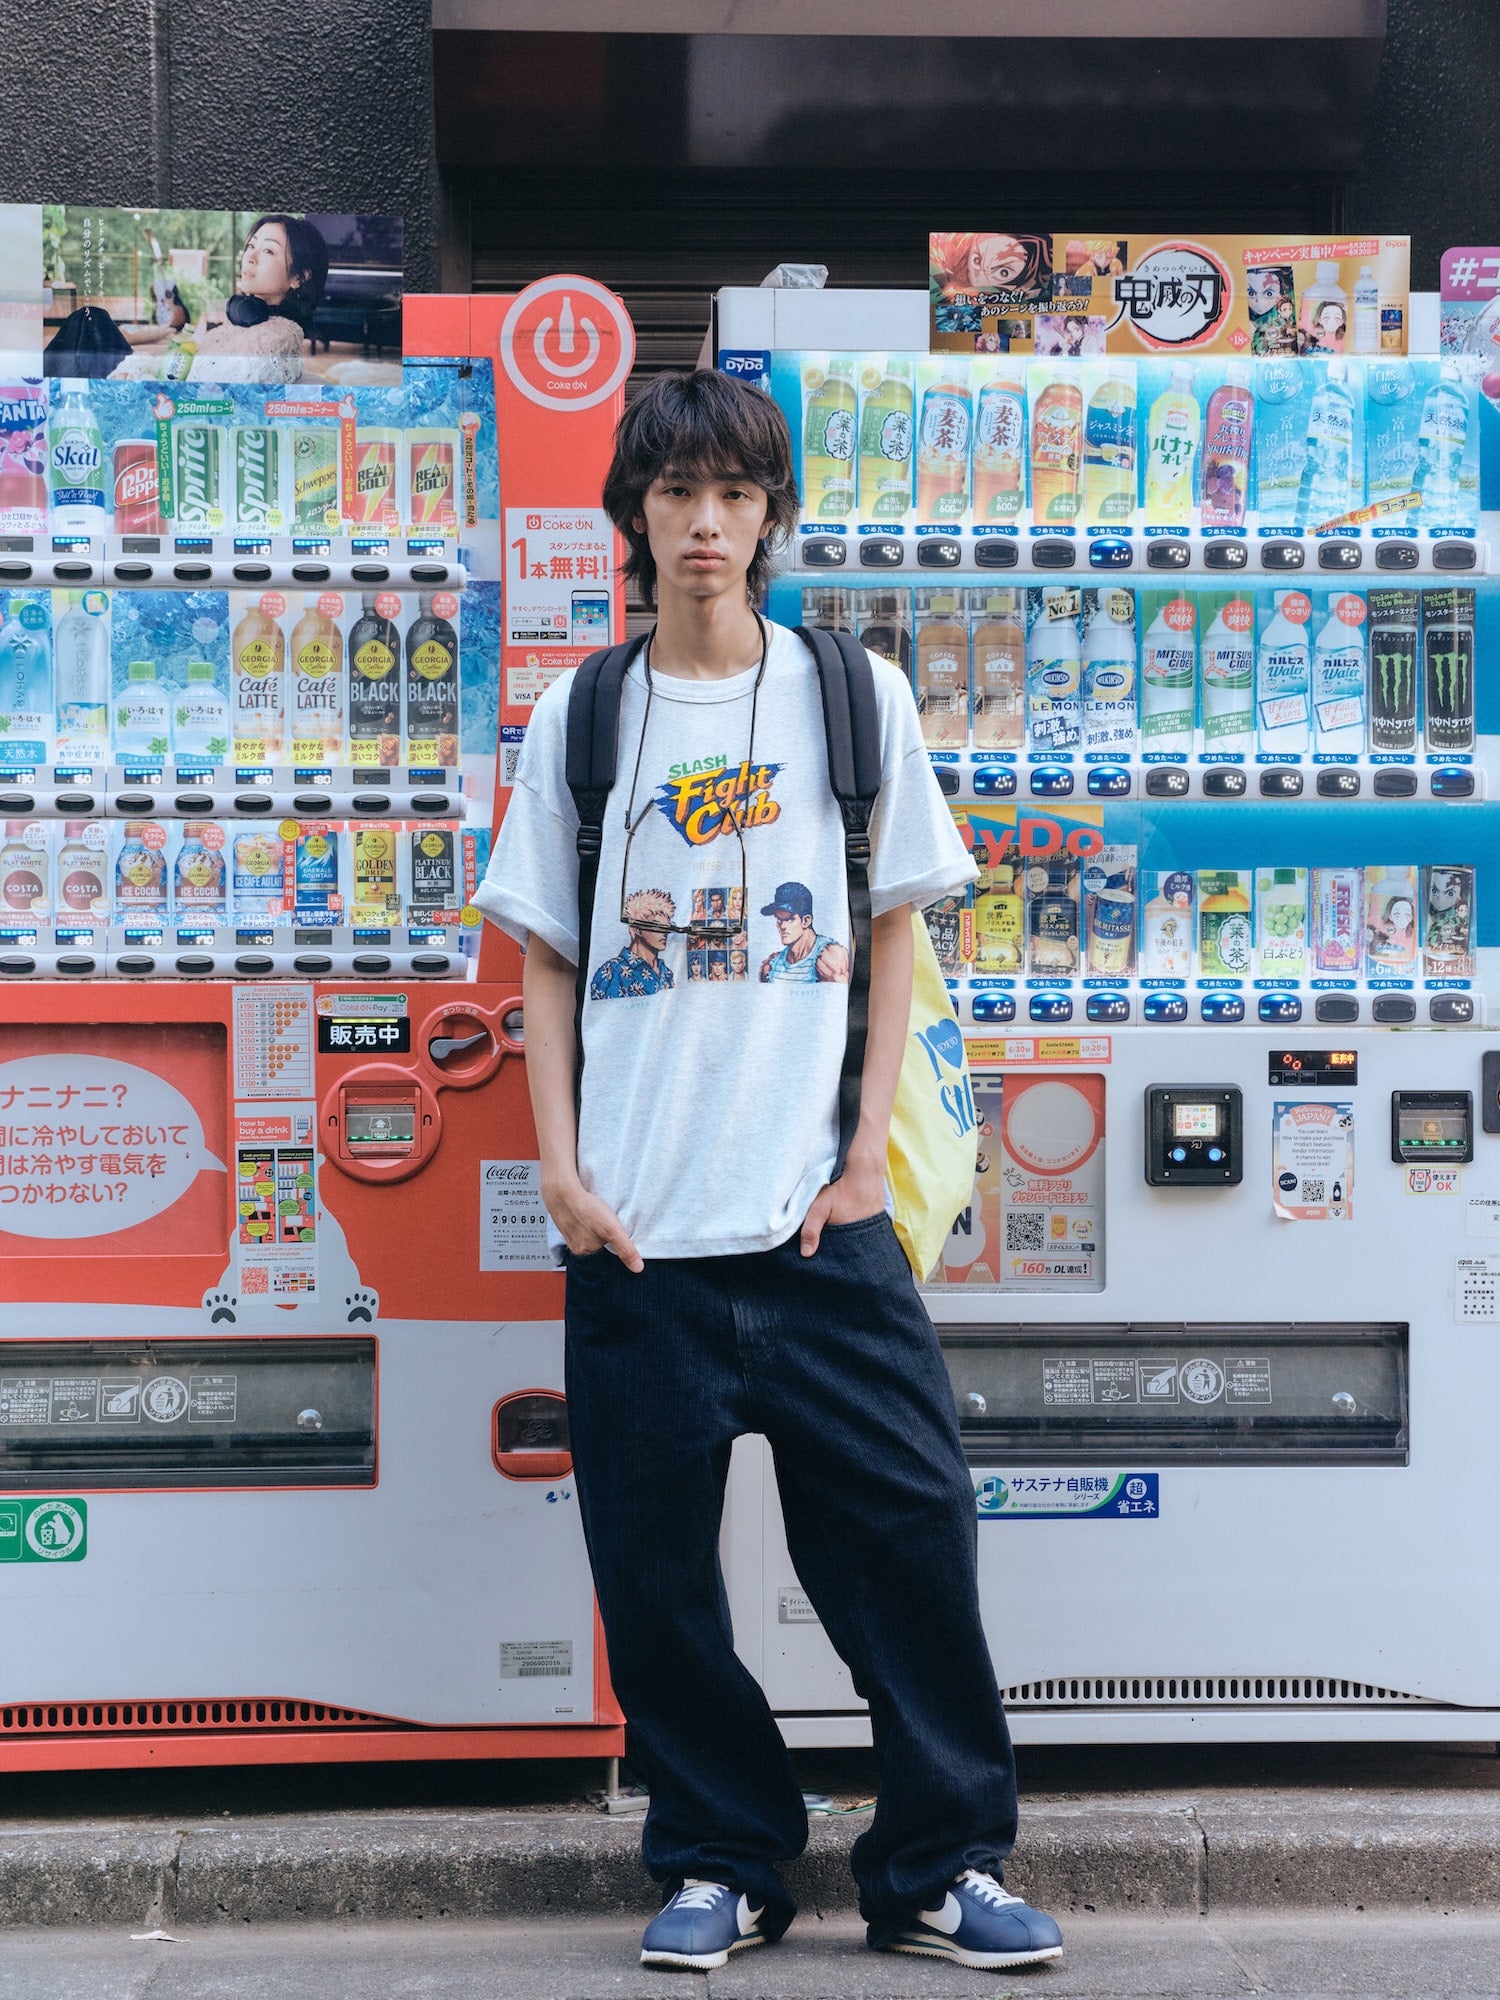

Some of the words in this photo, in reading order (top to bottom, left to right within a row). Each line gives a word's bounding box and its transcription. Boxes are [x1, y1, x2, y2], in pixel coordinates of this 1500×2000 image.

[1244, 245, 1336, 264] キャンペーン実施中!
[1143, 264, 1208, 274] きめつのやいば
[954, 291, 1024, 306] 想いをつなぐ!
[1104, 272, 1221, 331] 鬼滅の刃
[981, 300, 1089, 316] あのシーンを振り返ろう!
[725, 358, 764, 372] DyDo
[546, 381, 571, 390] Coke
[991, 406, 1013, 446] 麦茶
[1312, 412, 1350, 429] 天然水
[1424, 412, 1464, 429] 天然水
[835, 412, 851, 457] 葉の茶
[890, 413, 906, 458] 葉の茶
[936, 409, 953, 448] 麦茶
[1089, 420, 1134, 437] ジャスミン茶
[1152, 437, 1194, 455] バナナ
[134, 467, 156, 481] Dr
[178, 429, 212, 522] Sprite
[238, 429, 269, 522] Sprite
[357, 464, 391, 480] REAL
[416, 464, 448, 482] REAL
[294, 471, 338, 497] Schweppes
[357, 477, 390, 493] GOLD
[415, 477, 448, 494] GOLD
[542, 520, 573, 530] Coke
[549, 542, 607, 550] スタンプたまると
[511, 537, 608, 580] 1本無料!
[1168, 614, 1192, 626] 爽快
[1371, 607, 1418, 618] モンスターエナジー
[1227, 615, 1250, 627] 爽快
[241, 655, 277, 664] GEORGIA
[357, 655, 392, 664] GEORGIA
[542, 657, 563, 665] Coke
[929, 652, 956, 660] COFFEE
[1267, 656, 1305, 666] カルピス
[1323, 658, 1359, 668] カルピス
[1266, 662, 1305, 678] Water
[1322, 665, 1360, 681] Water
[238, 677, 278, 691] Café
[297, 677, 336, 691] Café
[350, 681, 400, 702] BLACK
[407, 681, 457, 702] BLACK
[238, 694, 278, 710] LATTE
[297, 694, 337, 710] LATTE
[1032, 701, 1079, 711] LEMON
[1086, 701, 1135, 711] LEMON
[5, 749, 39, 759] 天然水
[234, 742, 266, 751] 軽やかな
[235, 752, 266, 761] ミルク感
[668, 754, 728, 780] SLASH
[664, 761, 776, 826] Fight
[356, 859, 394, 871] GOLDEN
[414, 859, 451, 867] PLATINUM
[285, 844, 294, 909] お手頃価格!
[414, 865, 452, 880] BLACK
[6, 884, 40, 893] COSTA
[65, 884, 99, 893] COSTA
[121, 887, 133, 897] ICE
[134, 887, 161, 897] COCOA
[180, 887, 192, 897] ICE
[193, 887, 219, 897] COCOA
[1336, 886, 1351, 937] FRISK
[1093, 918, 1132, 934] DEMITASSE
[1229, 922, 1245, 963] 葉の茶
[1263, 948, 1304, 960] 白ぶどう
[340, 1004, 360, 1012] Coke
[372, 1004, 388, 1013] Pay
[329, 1025, 400, 1046] 販売中
[1331, 1053, 1355, 1065] 販売中
[1296, 1112, 1331, 1124] JAPAN!
[239, 1127, 256, 1135] buy
[0, 1153, 167, 1175] は冷やす電気を
[0, 1182, 128, 1204] つかわない?
[1027, 1179, 1072, 1192] 無料アプリ
[1436, 1181, 1453, 1191] OK
[1012, 1191, 1088, 1204] ダウンロードはコチラ
[1011, 1477, 1109, 1492] サステナ自販機
[1129, 1481, 1144, 1496] 超
[1073, 1492, 1100, 1500] シリーズ
[33, 1504, 77, 1519] のんだあとは
[1117, 1499, 1156, 1514] 省エネ
[38, 1545, 73, 1558] リサイクル
